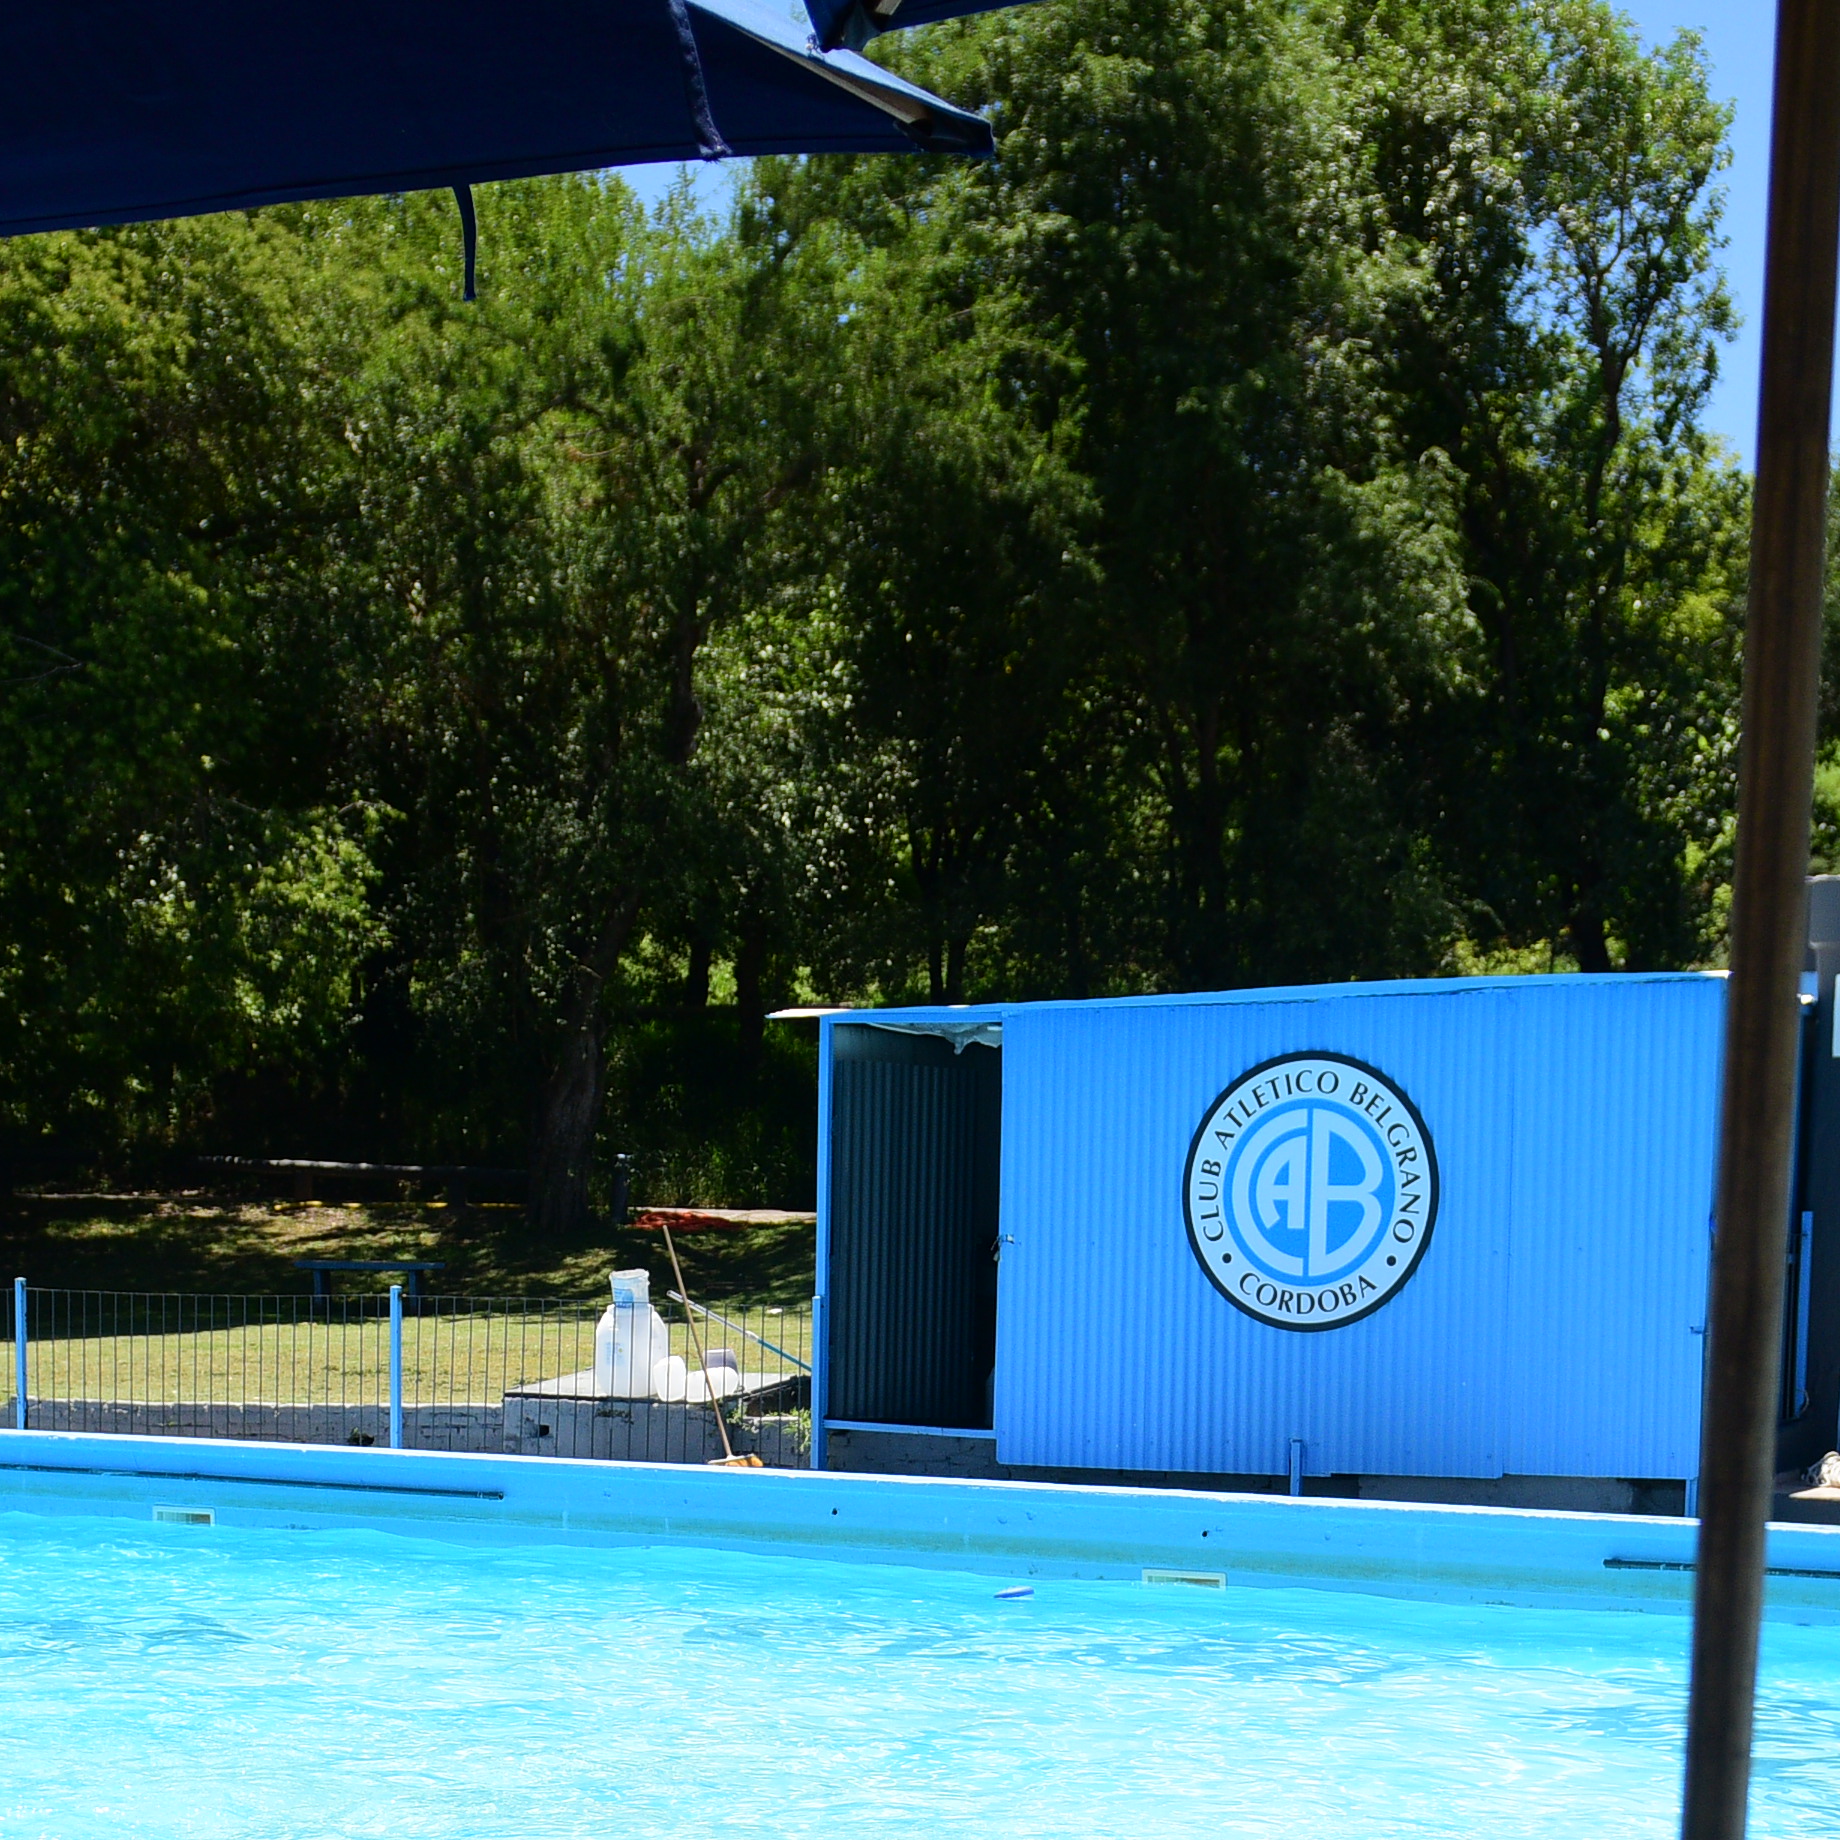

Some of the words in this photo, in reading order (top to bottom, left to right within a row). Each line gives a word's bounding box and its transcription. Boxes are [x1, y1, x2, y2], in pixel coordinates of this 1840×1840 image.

[1198, 1158, 1224, 1242] CLUB
[1214, 1069, 1340, 1150] ATLETICO
[1348, 1081, 1422, 1244] BELGRANO
[1238, 1272, 1378, 1315] CORDOBA
